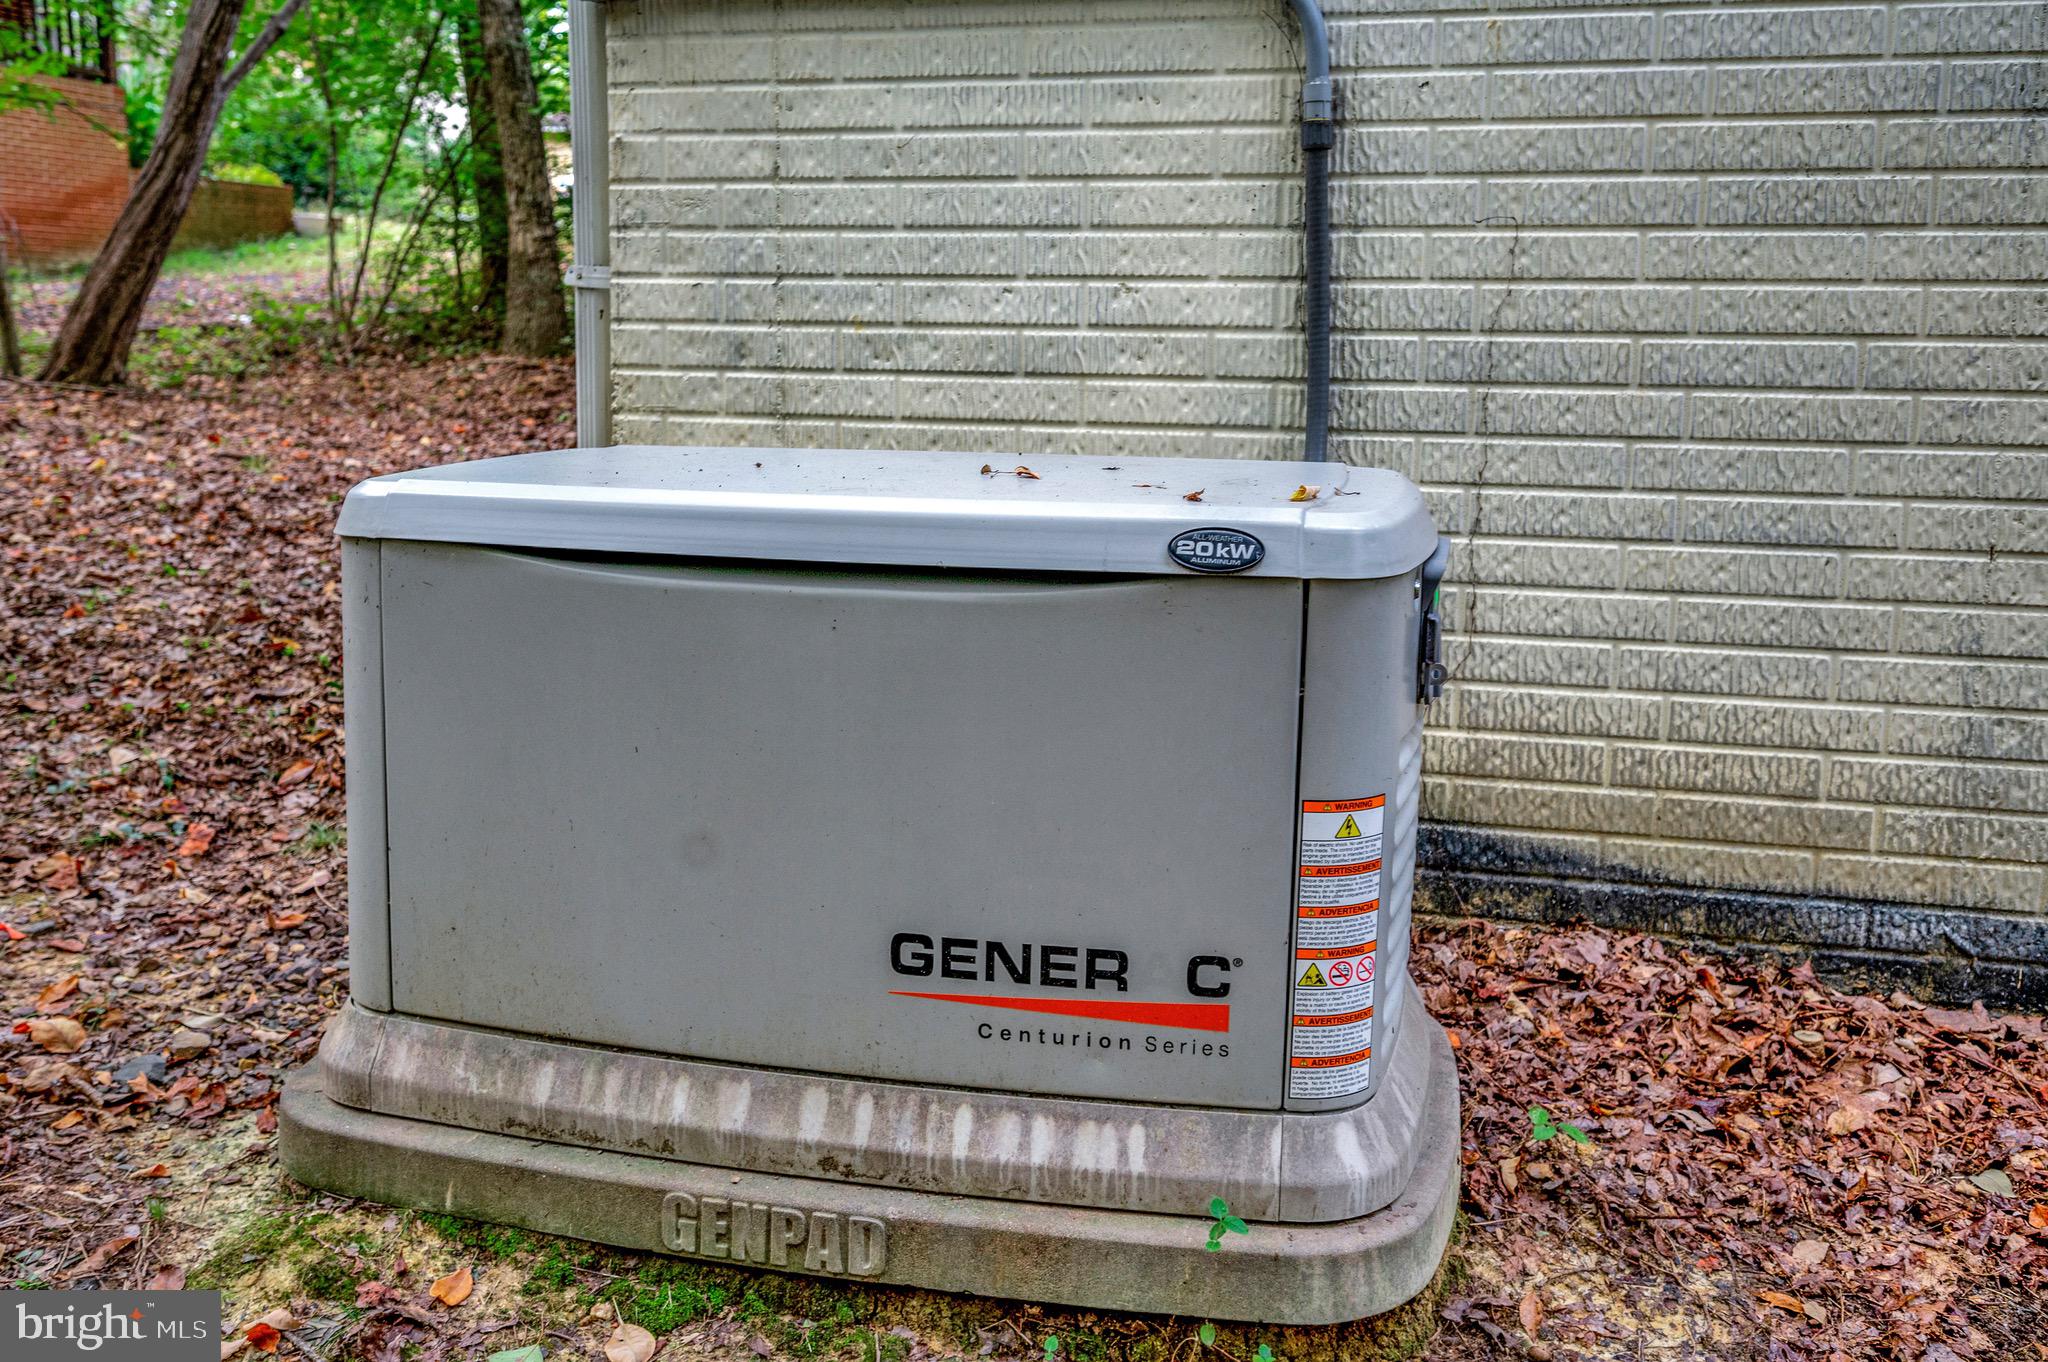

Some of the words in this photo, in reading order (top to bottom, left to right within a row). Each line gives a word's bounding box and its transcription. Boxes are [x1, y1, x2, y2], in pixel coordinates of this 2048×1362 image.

[1190, 557, 1240, 566] ALUMINUM
[1334, 800, 1372, 810] WARNING
[1316, 861, 1379, 875] AVERTISSEMENT
[1320, 903, 1374, 916] ADVERTENCIA
[1328, 946, 1364, 957] WARNING
[1309, 1008, 1371, 1024] AVERTISSEMENT
[978, 1023, 1131, 1050] Centurion
[1145, 1036, 1230, 1057] Series
[1310, 1052, 1365, 1066] ADVERTENCIA
[661, 1191, 887, 1277] GENPAD
